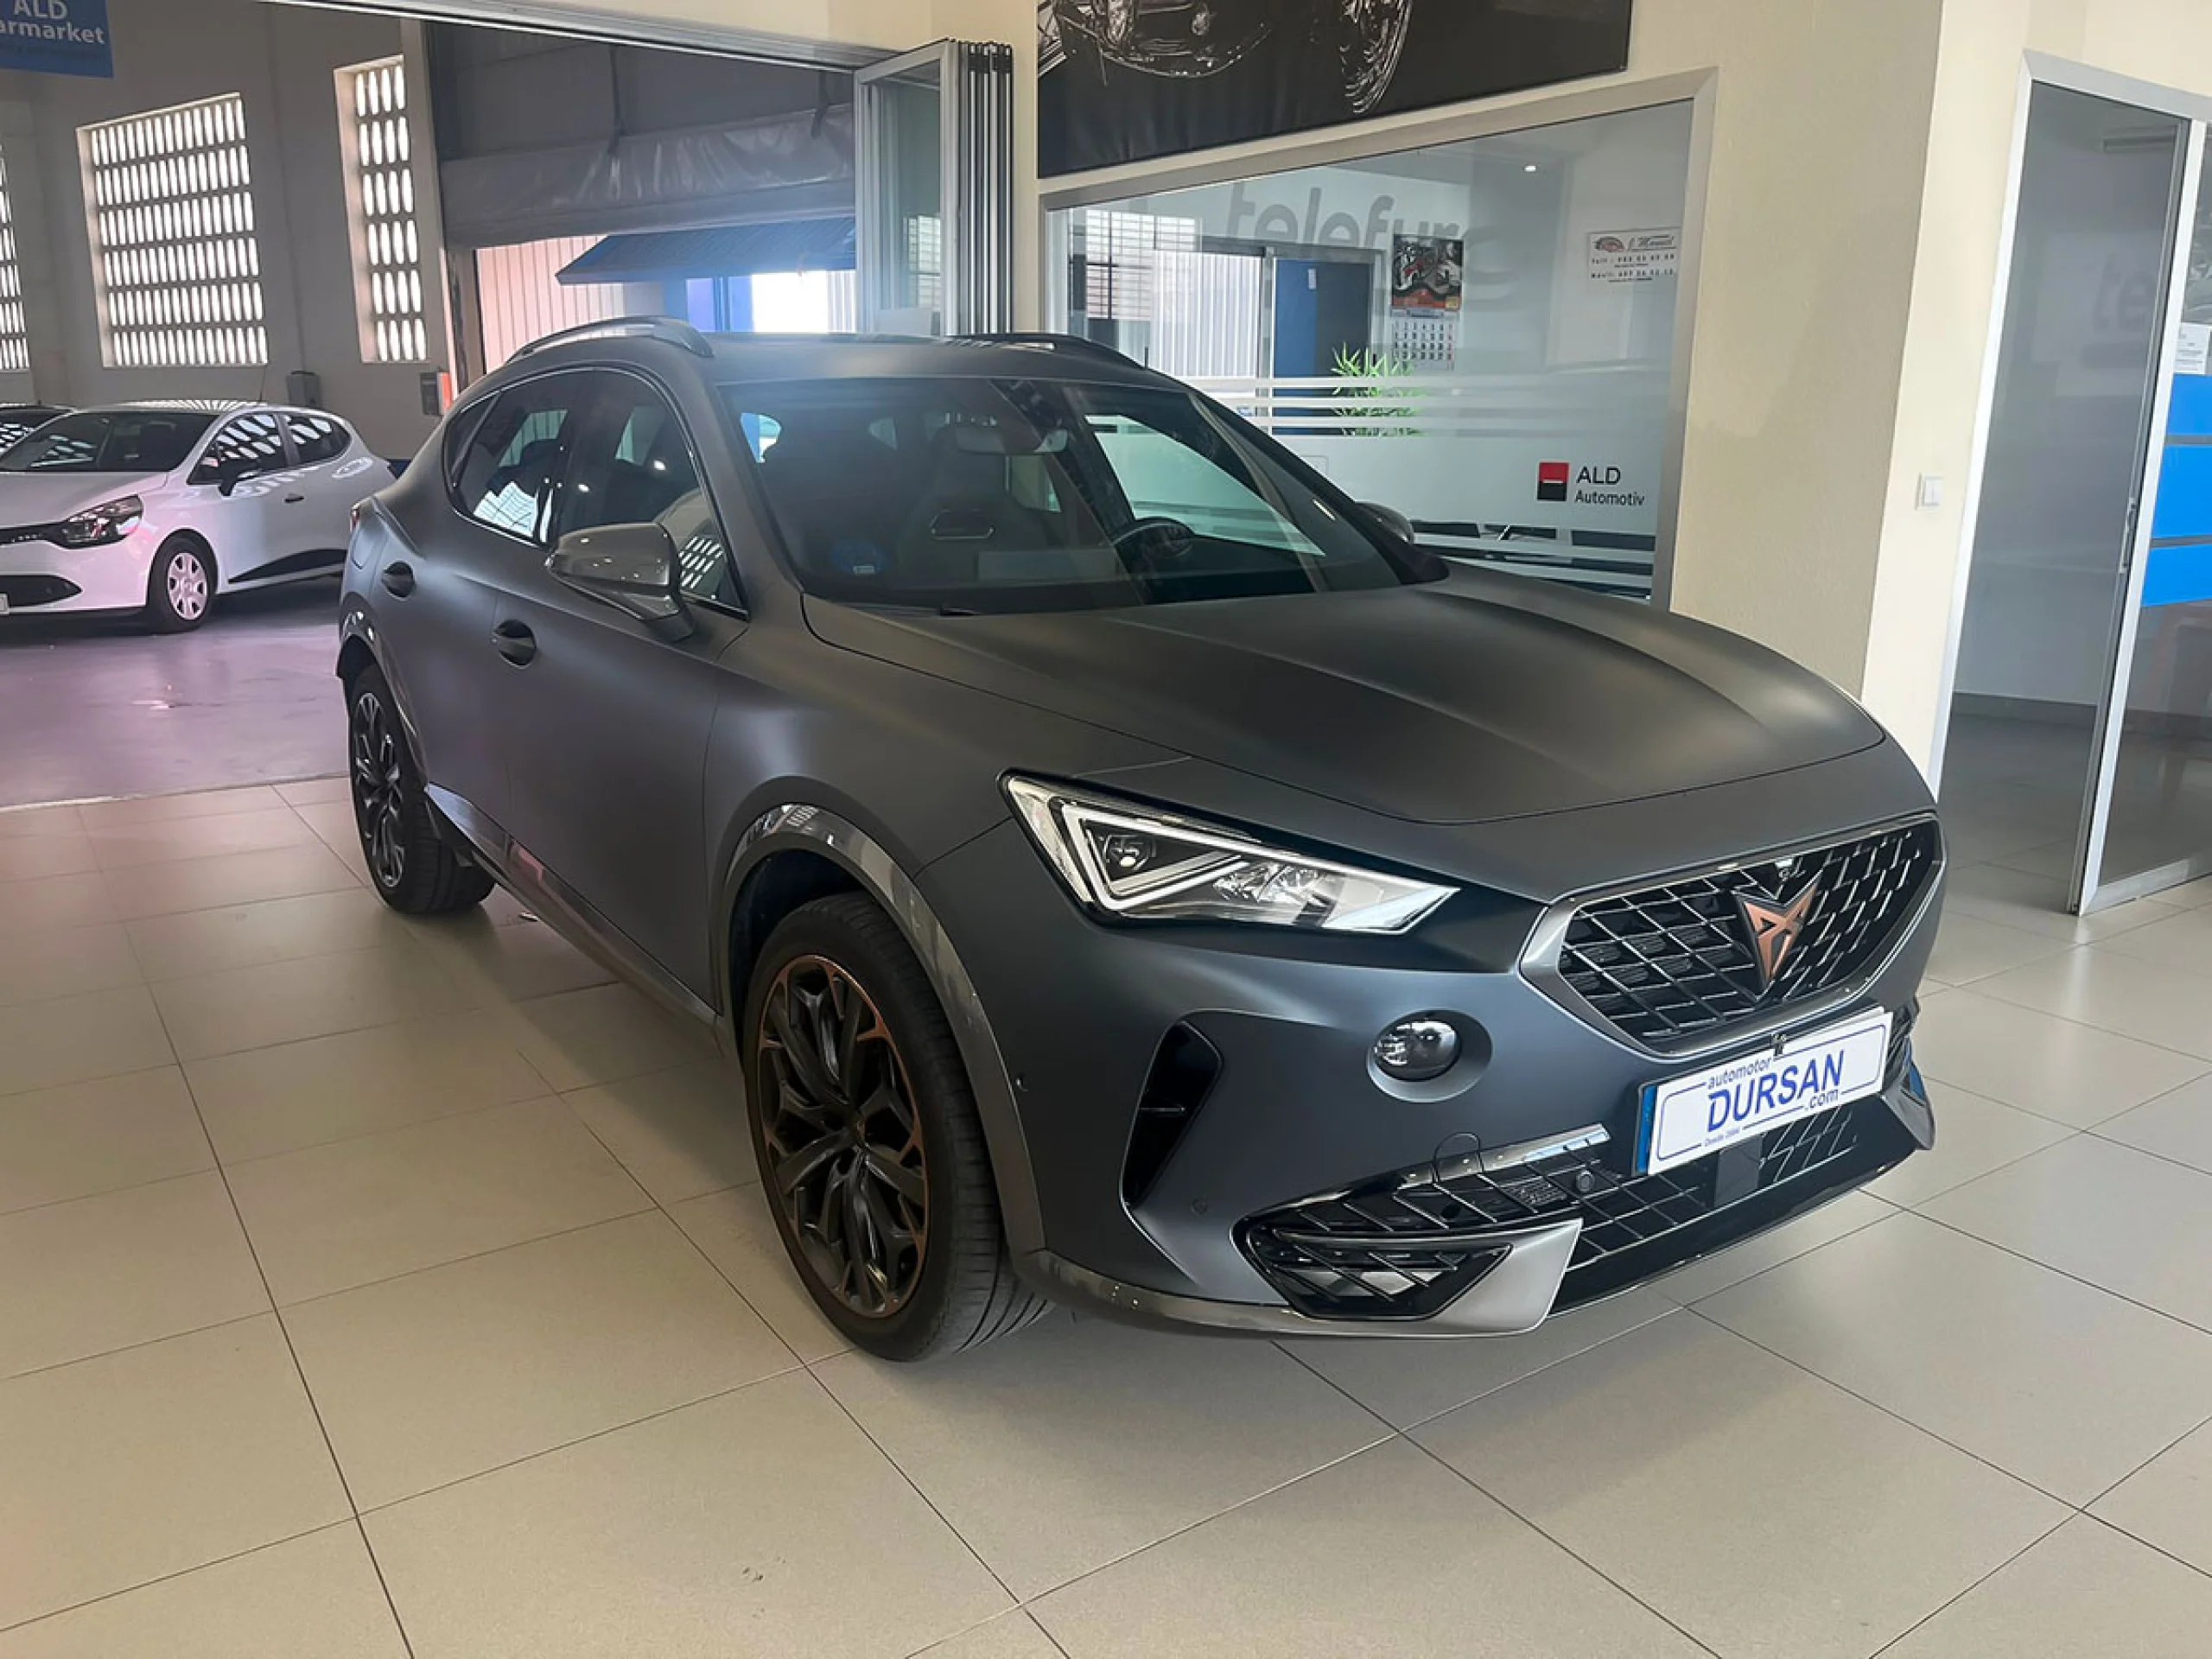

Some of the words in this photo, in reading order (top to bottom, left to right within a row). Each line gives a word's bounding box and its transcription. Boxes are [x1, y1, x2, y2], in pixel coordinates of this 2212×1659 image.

[13, 0, 67, 19] ALD
[1575, 466, 1621, 485] ALD
[1707, 1056, 1772, 1089] automotor
[1707, 1049, 1845, 1133] DURSAN
